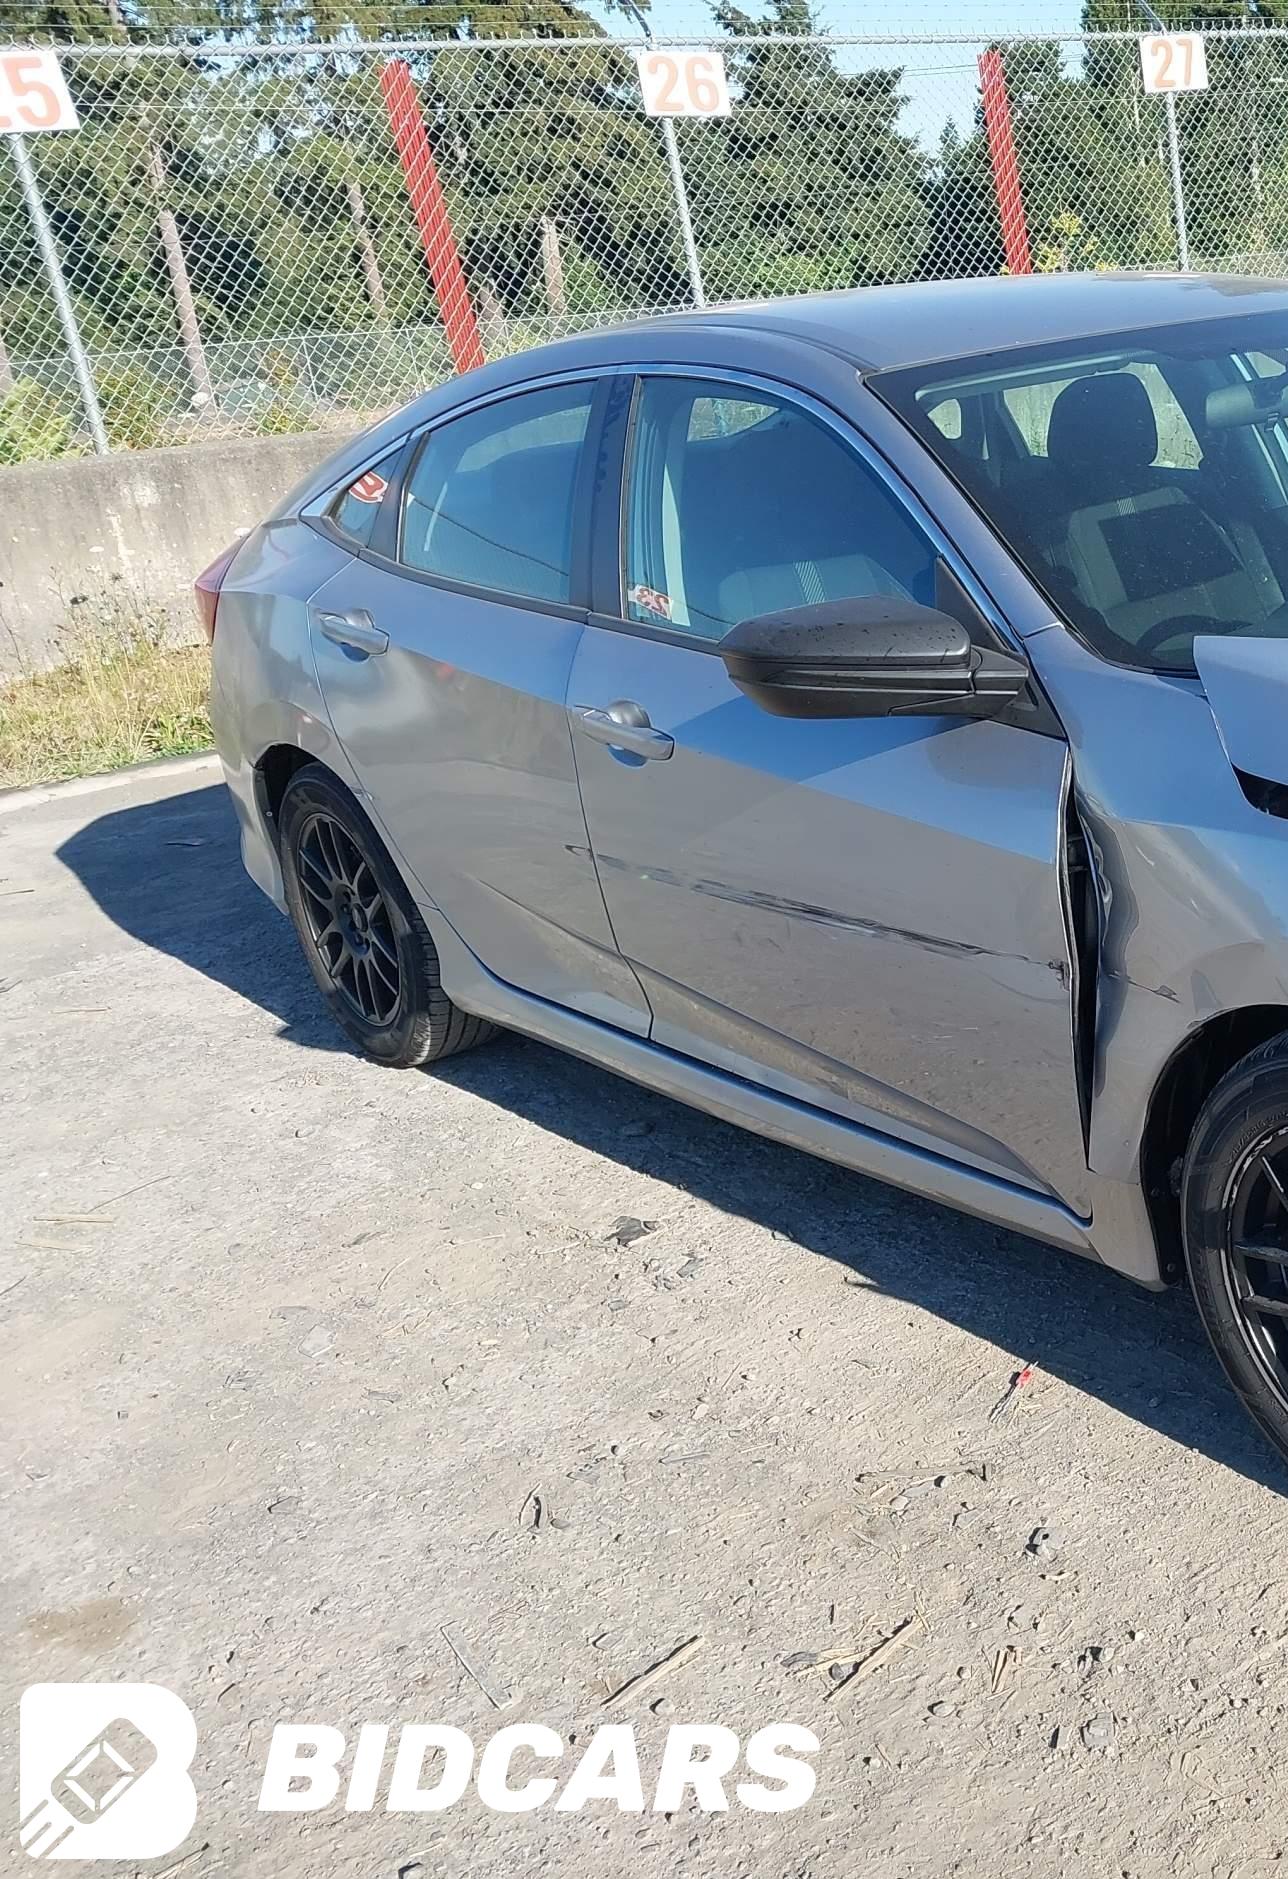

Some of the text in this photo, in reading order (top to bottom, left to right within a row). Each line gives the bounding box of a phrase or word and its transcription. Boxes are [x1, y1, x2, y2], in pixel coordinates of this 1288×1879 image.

[0, 55, 61, 128] 5
[646, 54, 719, 113] 26
[1150, 38, 1193, 88] 27
